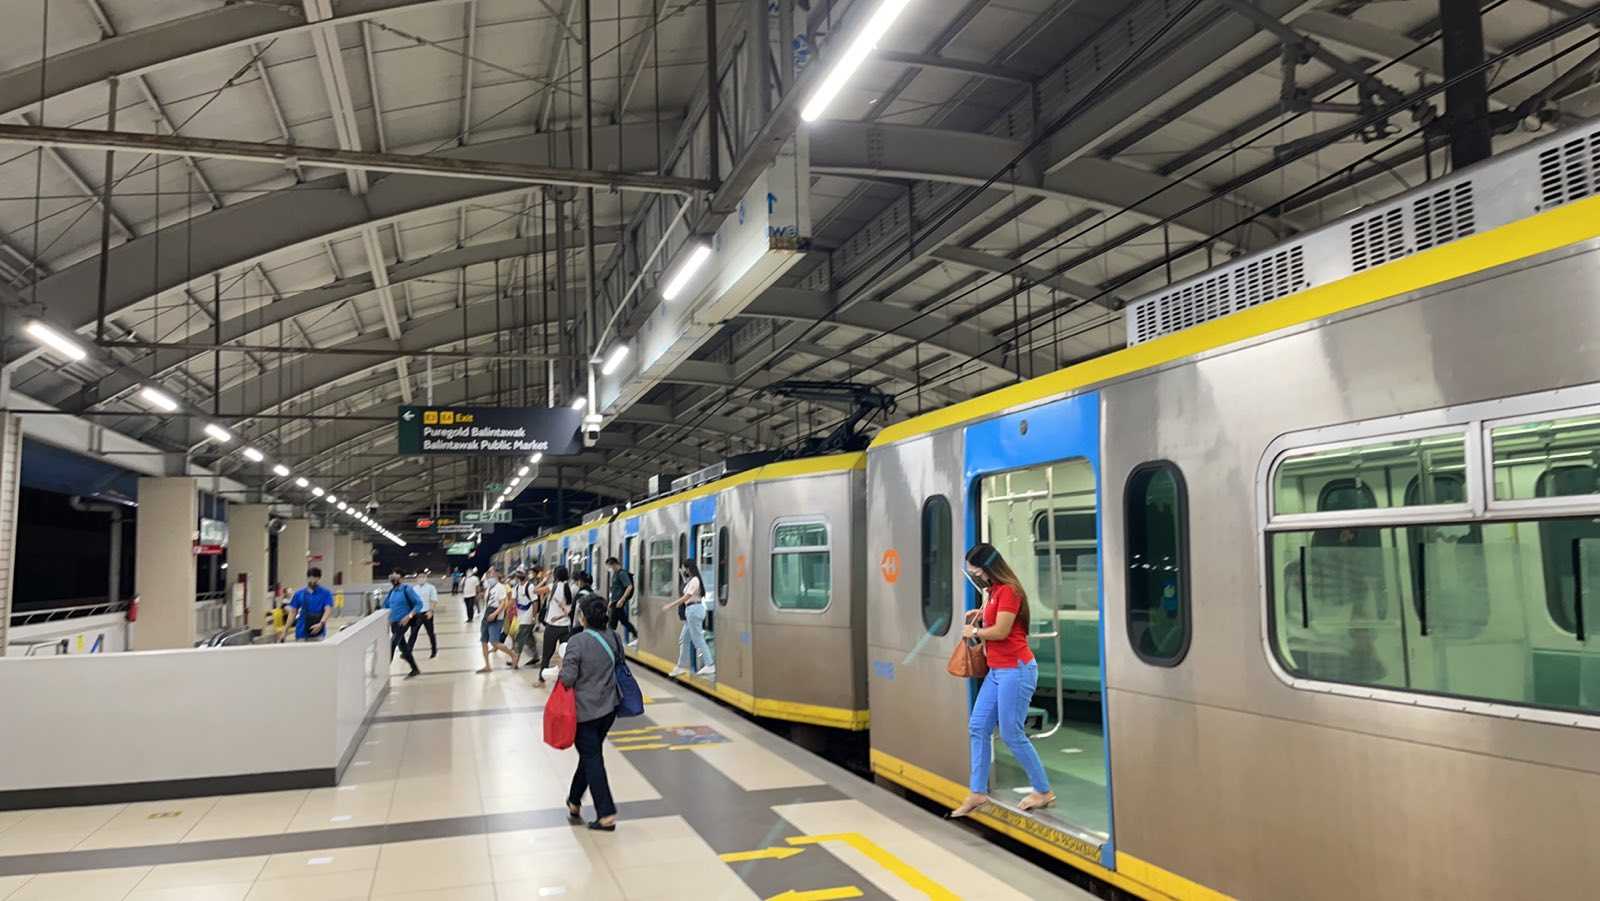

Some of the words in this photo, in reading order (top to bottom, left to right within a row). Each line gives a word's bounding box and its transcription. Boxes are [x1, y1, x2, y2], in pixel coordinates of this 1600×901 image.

[455, 412, 474, 423] Exit
[423, 427, 470, 439] Puregold
[471, 427, 526, 437] Balintawak
[423, 440, 479, 450] Balintawak
[480, 440, 512, 450] Public
[513, 440, 548, 450] Market
[479, 511, 506, 521] EXIT
